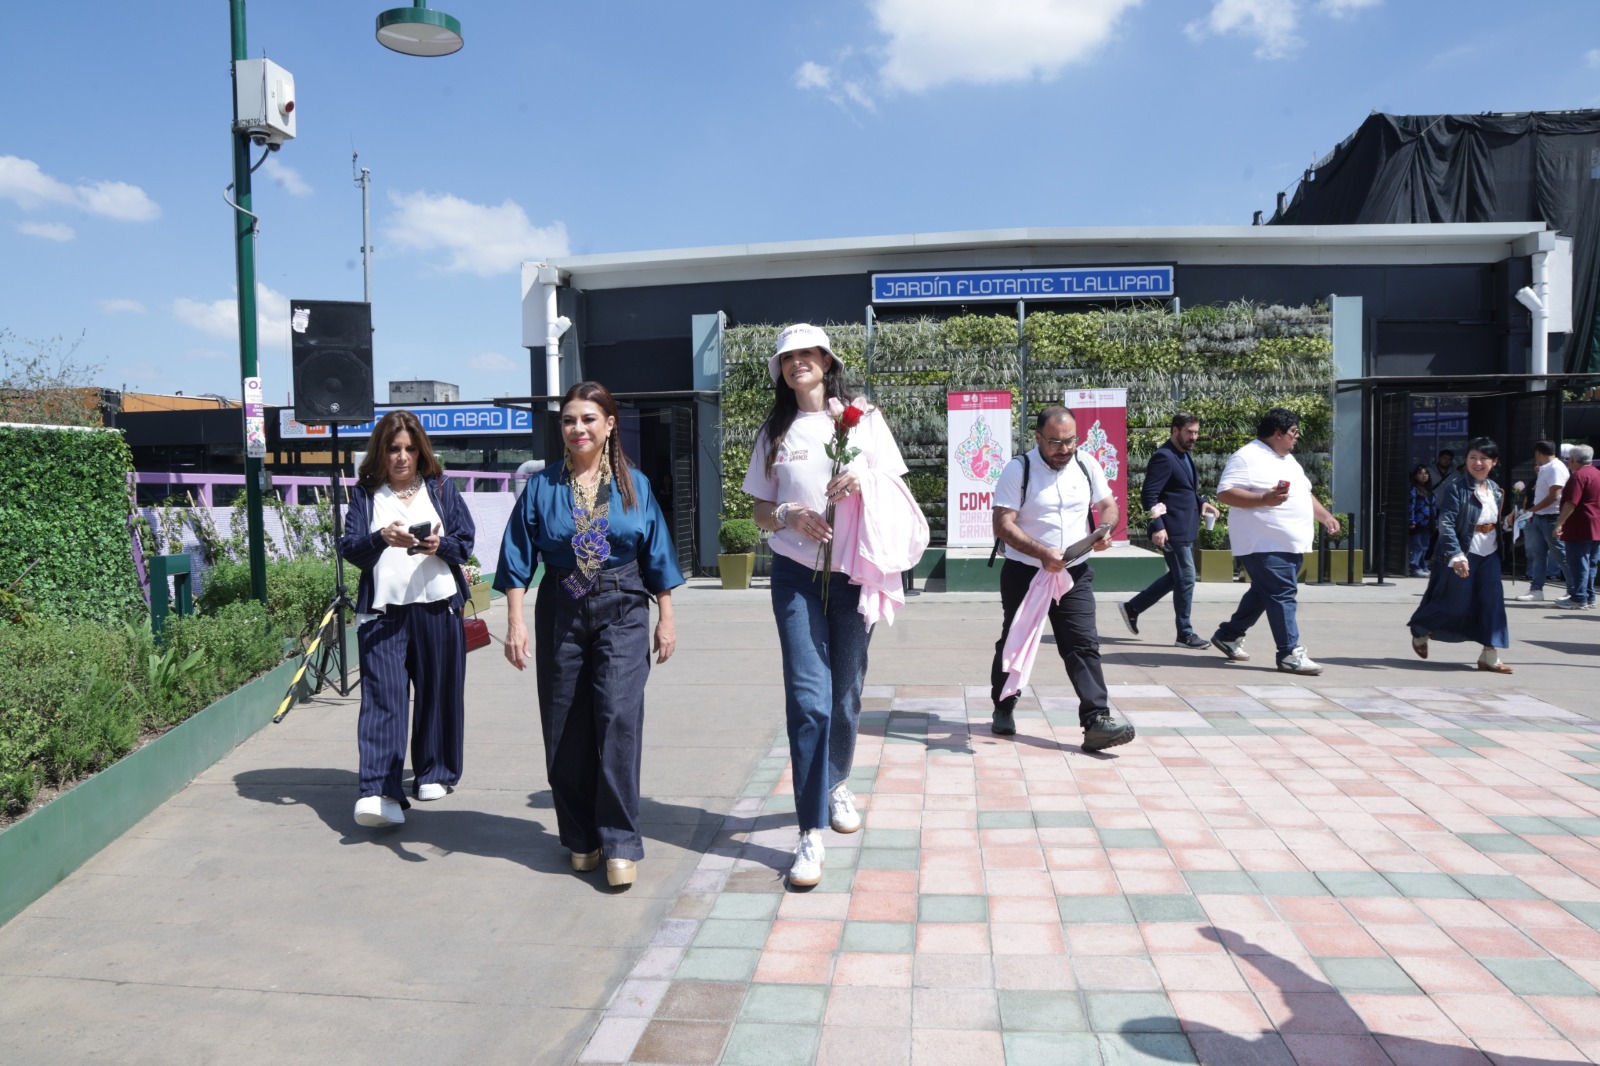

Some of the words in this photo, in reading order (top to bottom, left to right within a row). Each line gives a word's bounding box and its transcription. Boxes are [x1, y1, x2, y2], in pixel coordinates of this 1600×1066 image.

[882, 276, 951, 297] JARDÍN
[957, 278, 1054, 295] FLOTANTE
[1060, 275, 1163, 292] TLALLIPAN
[453, 411, 503, 427] ABAD
[515, 411, 528, 426] 2
[959, 524, 994, 538] GRAND
